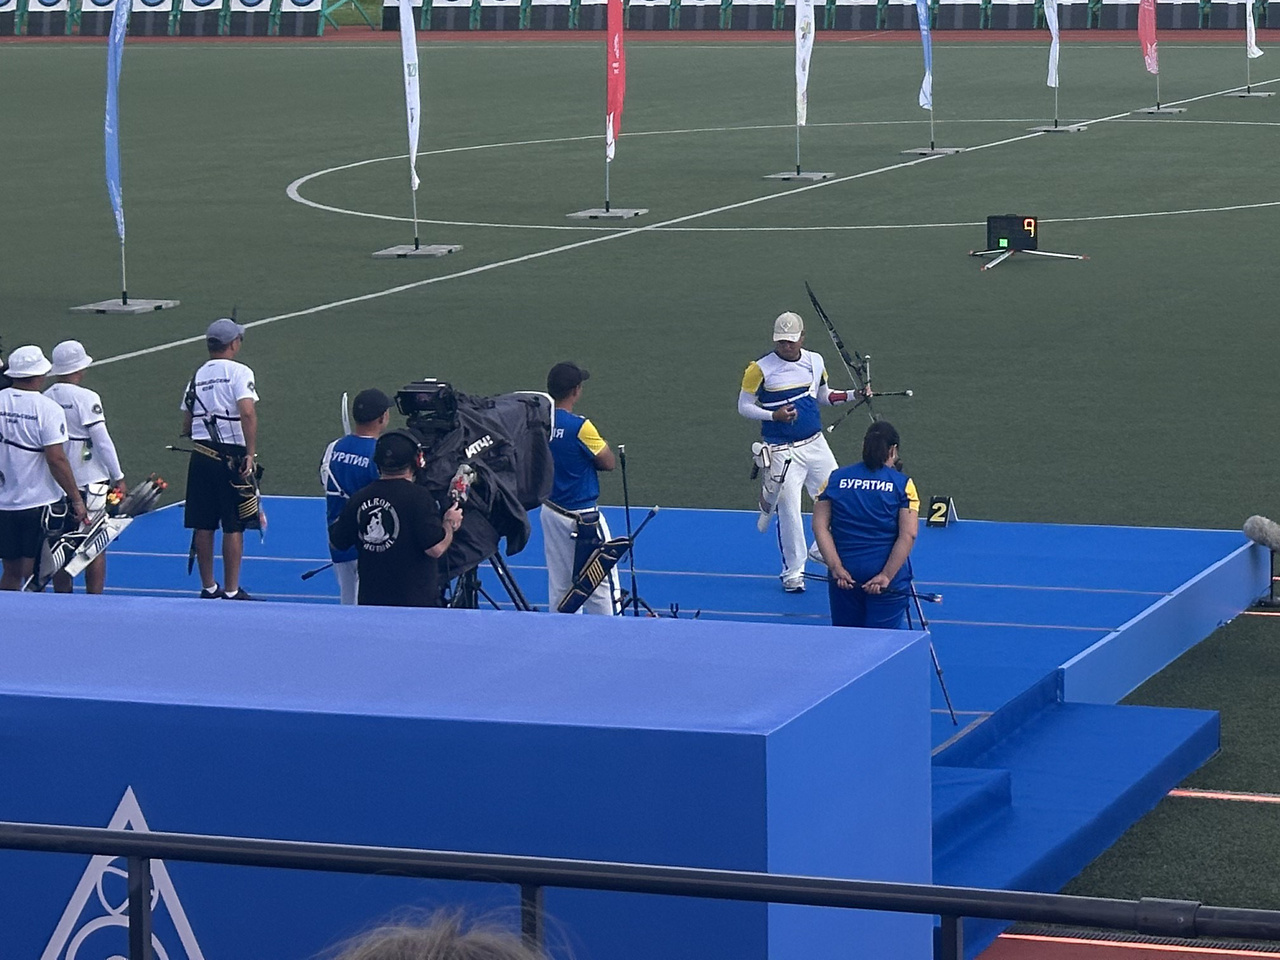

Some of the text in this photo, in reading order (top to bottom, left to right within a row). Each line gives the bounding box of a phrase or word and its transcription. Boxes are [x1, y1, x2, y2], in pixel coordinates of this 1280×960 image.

[1024, 218, 1035, 238] 9
[331, 451, 370, 468] УРЯТИЯ
[838, 478, 894, 492] БУРЯТИЯ
[929, 502, 947, 522] 2
